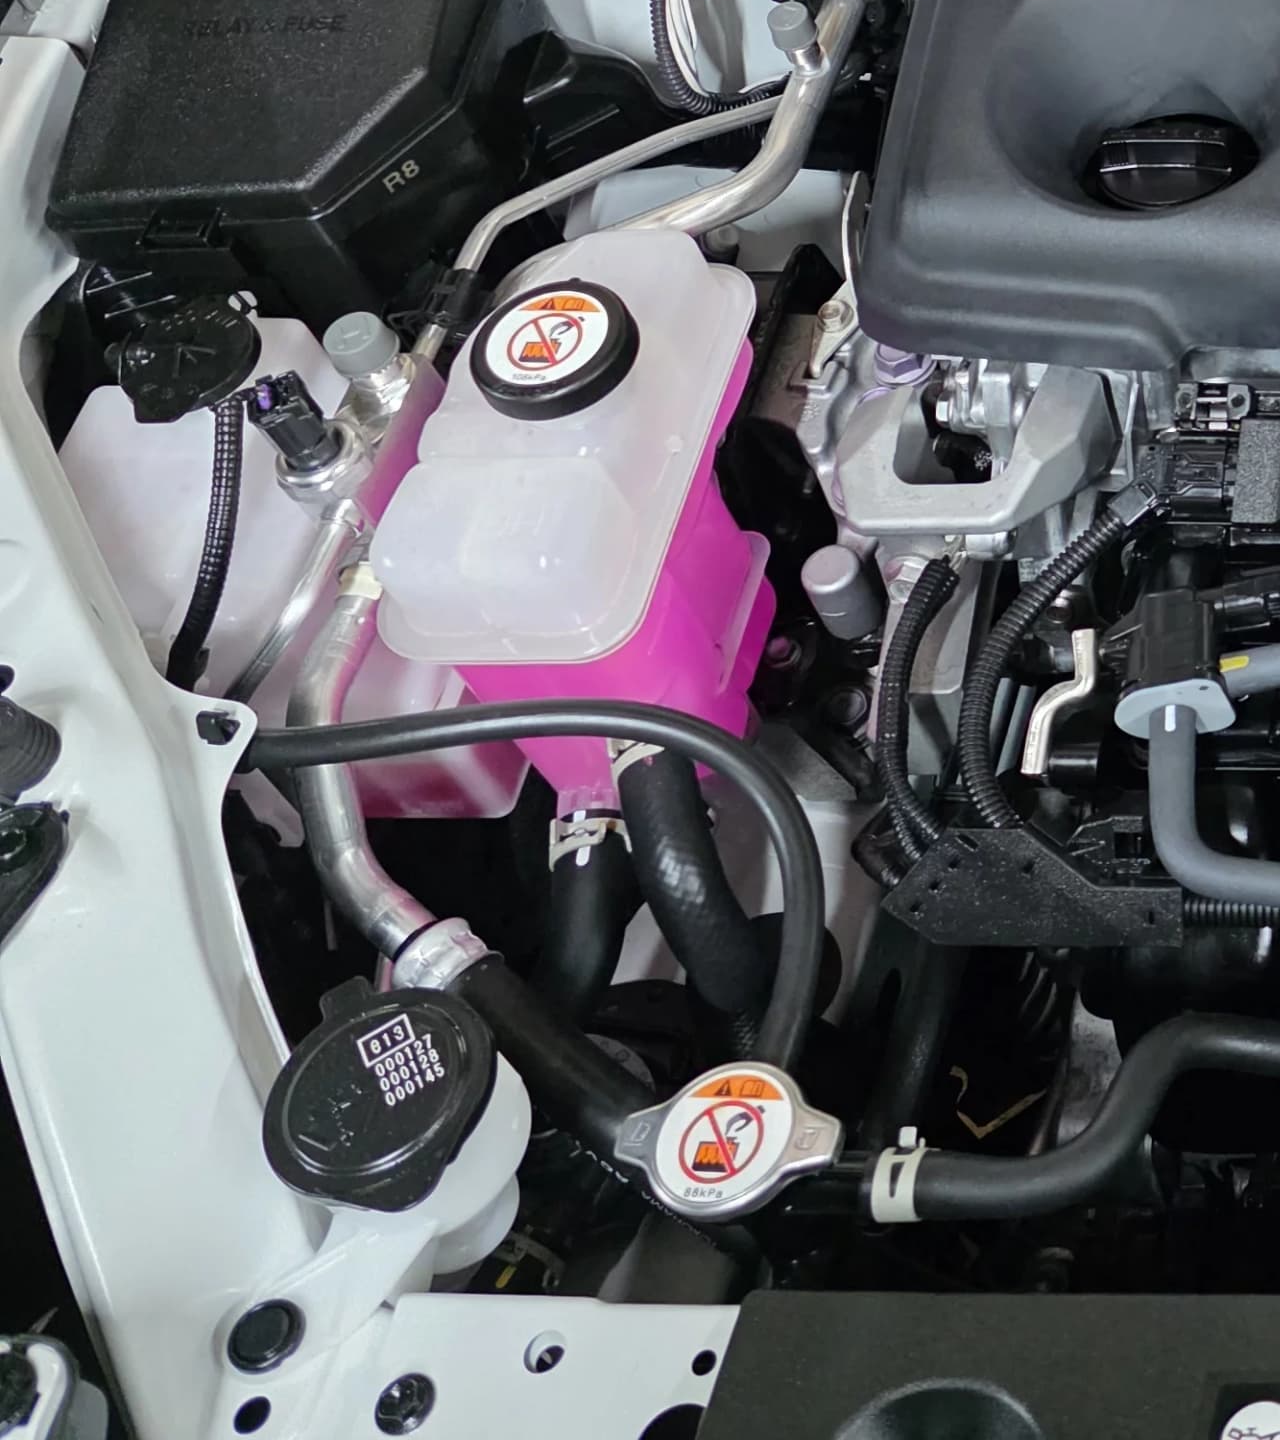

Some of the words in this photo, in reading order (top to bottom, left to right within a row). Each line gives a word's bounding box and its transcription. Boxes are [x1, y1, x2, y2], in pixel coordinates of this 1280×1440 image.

[286, 14, 348, 33] FUSE
[381, 159, 421, 194] R8
[375, 1033, 433, 1077] 000127
[380, 1048, 440, 1091] 000128
[385, 1062, 446, 1107] 000145
